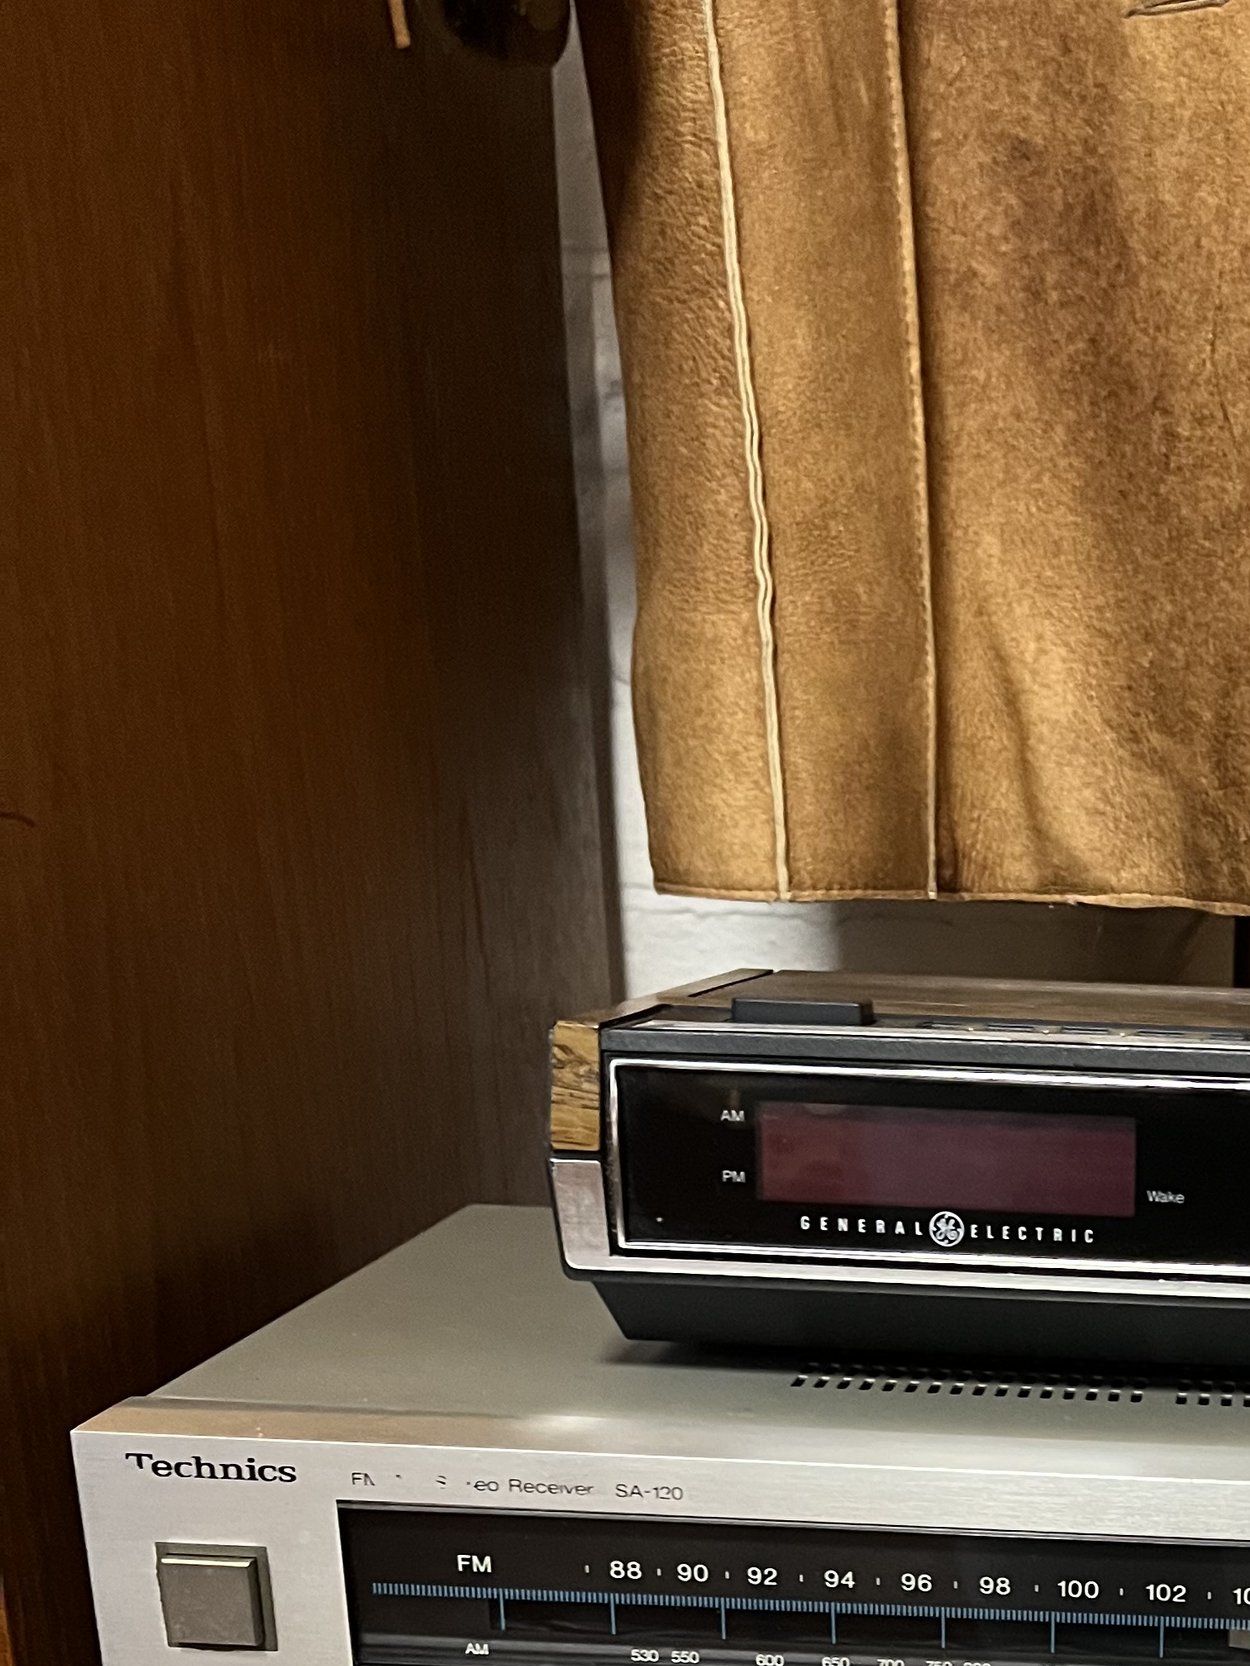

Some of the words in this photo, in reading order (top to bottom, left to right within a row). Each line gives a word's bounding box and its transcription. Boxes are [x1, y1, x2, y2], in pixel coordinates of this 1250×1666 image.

[720, 1109, 745, 1122] AM
[722, 1170, 746, 1183] PM
[1147, 1190, 1185, 1204] Wake
[800, 1215, 925, 1236] GENERAL
[970, 1223, 1095, 1244] ELECTRIC
[125, 1452, 296, 1483] Technics
[508, 1479, 594, 1497] Receiver
[615, 1484, 683, 1501] SA-120
[457, 1555, 492, 1573] FM
[609, 1561, 643, 1580] 88
[676, 1563, 709, 1582] 90
[747, 1567, 778, 1586] 92
[824, 1570, 855, 1588] 94
[900, 1573, 932, 1592] 96
[979, 1576, 1011, 1595] 98
[1057, 1580, 1099, 1599] 100
[1146, 1583, 1187, 1602] 102
[465, 1642, 490, 1655] AM
[631, 1649, 660, 1662] 530
[671, 1650, 700, 1664] 550
[755, 1654, 785, 1666] 600
